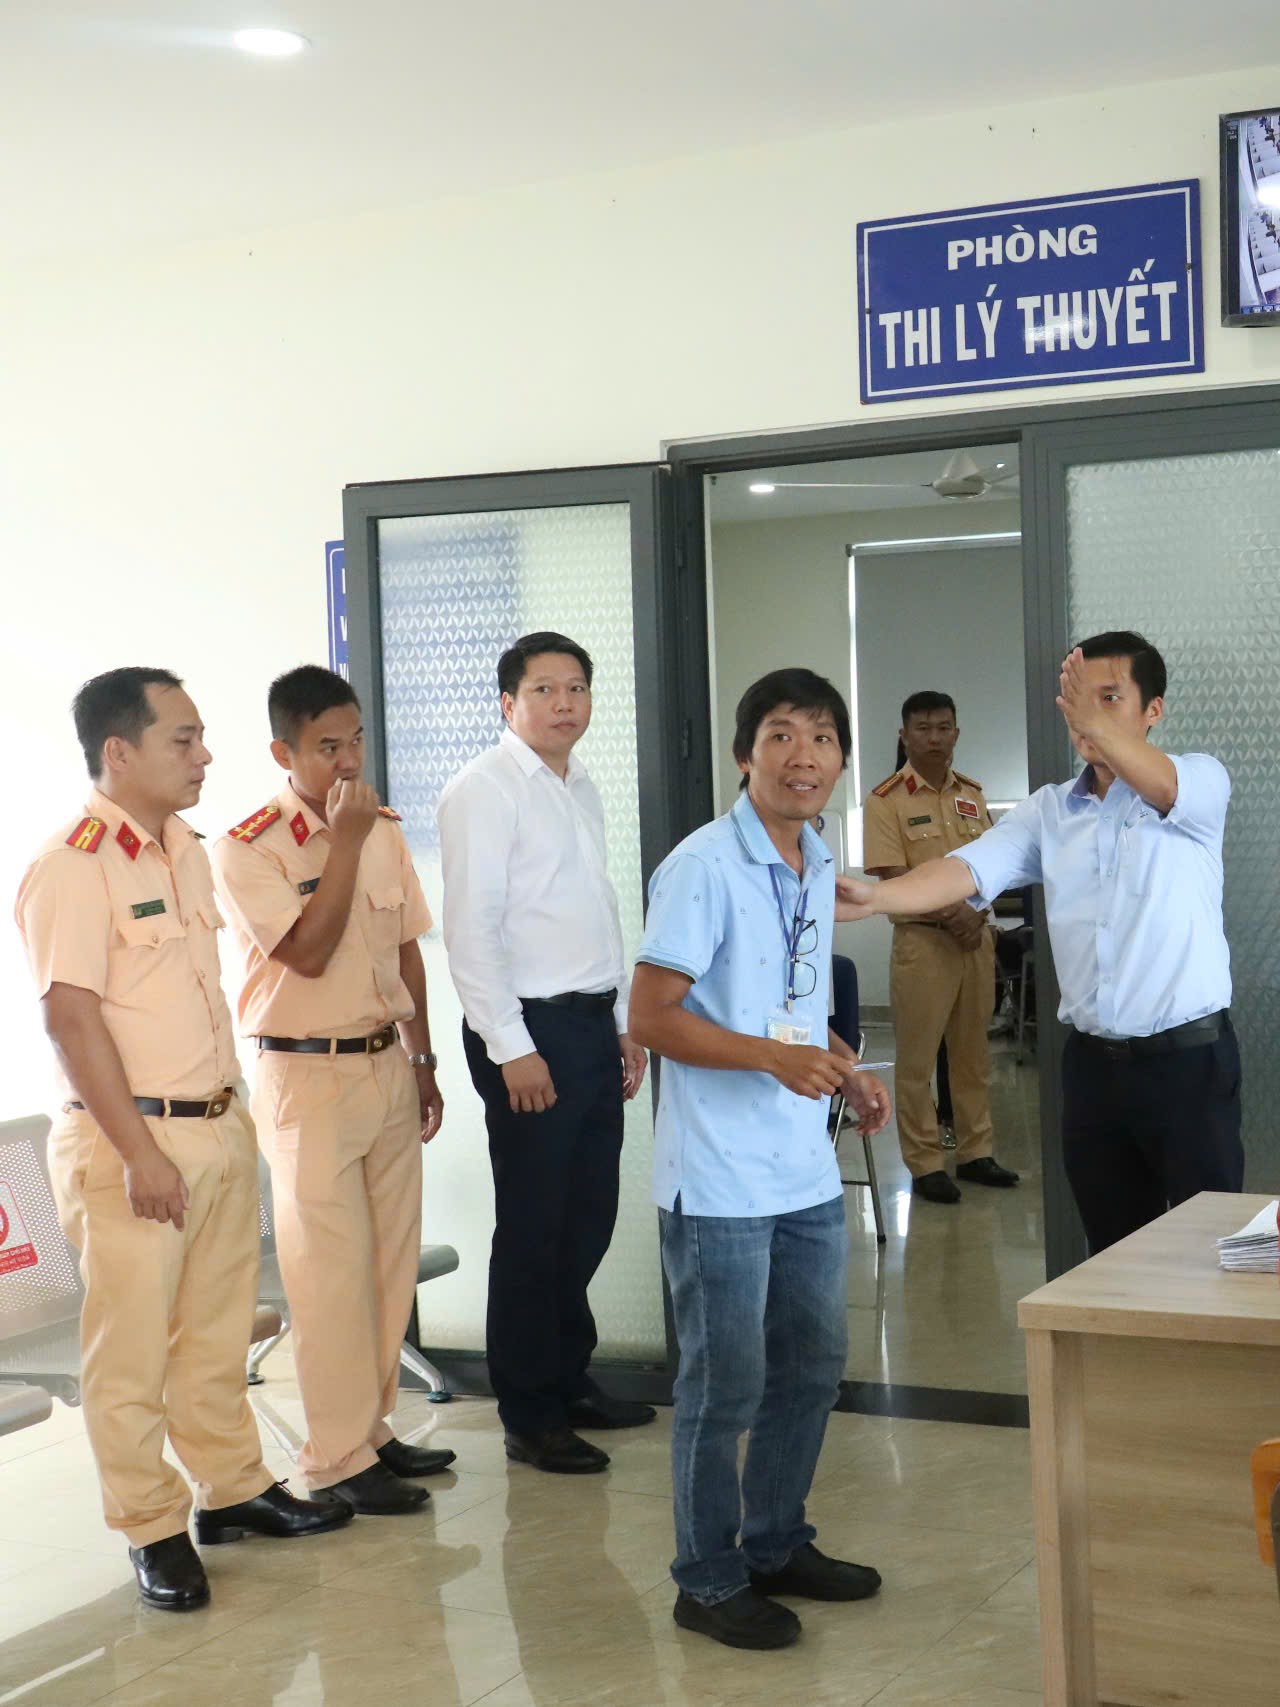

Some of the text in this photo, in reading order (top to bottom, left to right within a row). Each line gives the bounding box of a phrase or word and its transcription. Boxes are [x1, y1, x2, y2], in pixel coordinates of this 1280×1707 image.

[947, 224, 1098, 270] PHÒNG
[879, 259, 1177, 369] THI LÝ THUYẾT
